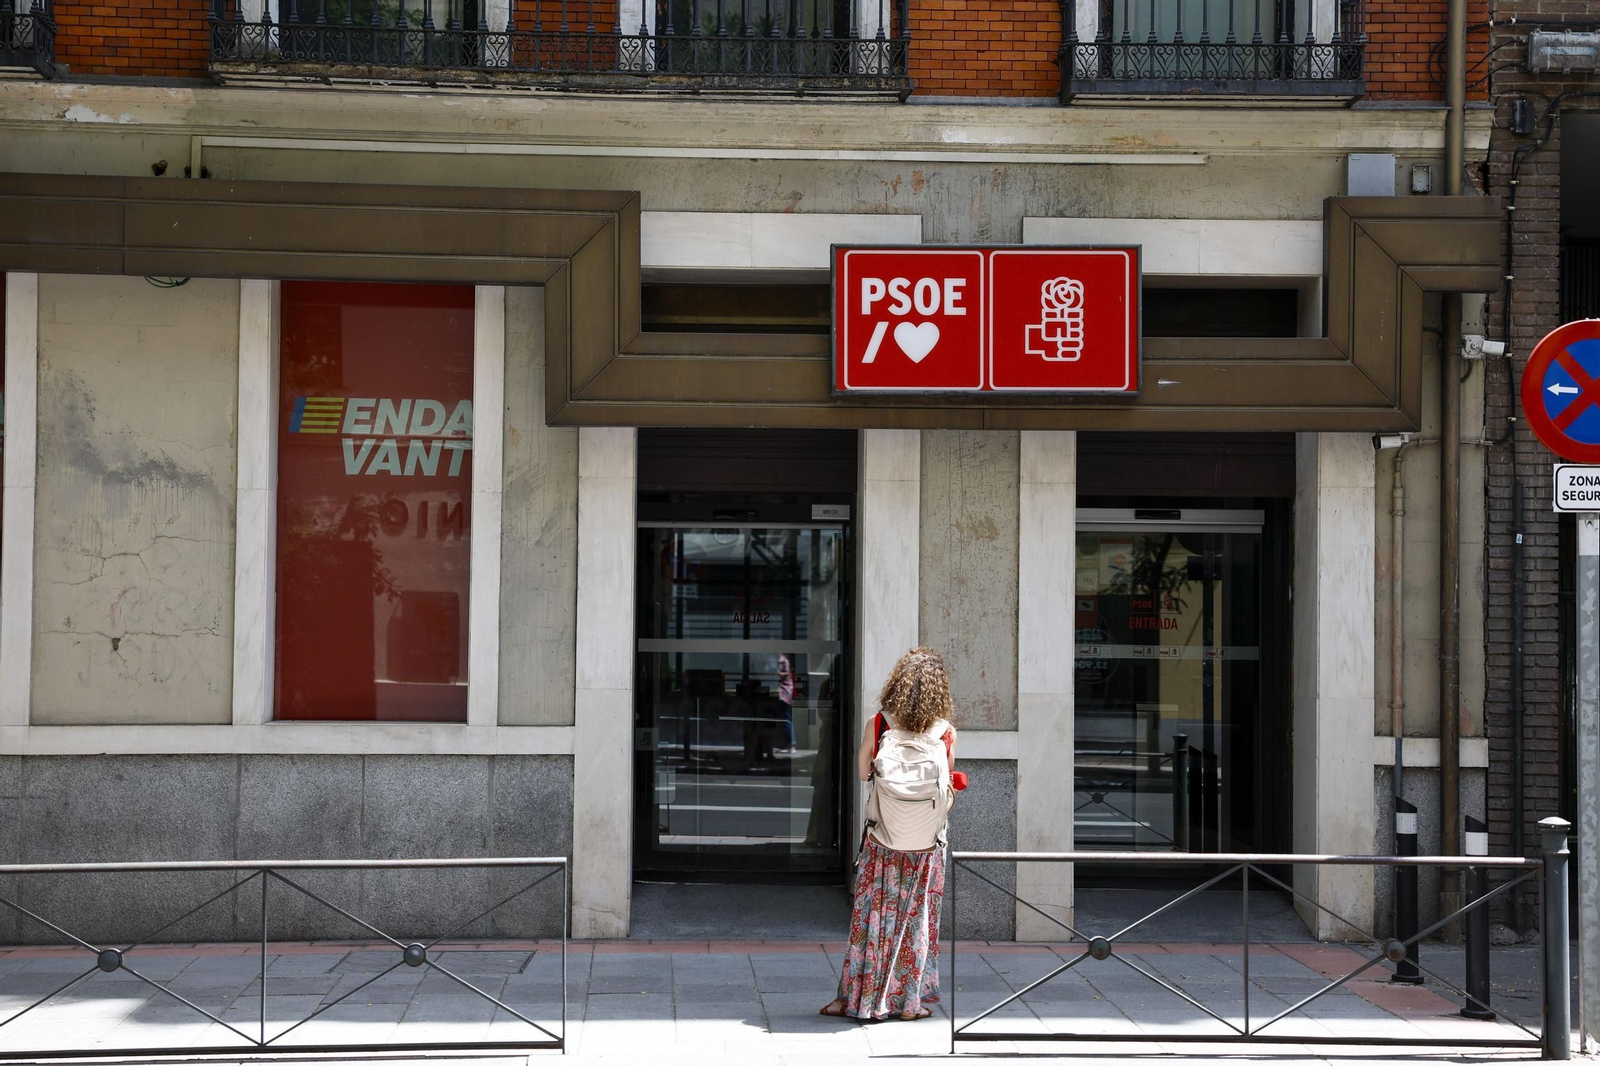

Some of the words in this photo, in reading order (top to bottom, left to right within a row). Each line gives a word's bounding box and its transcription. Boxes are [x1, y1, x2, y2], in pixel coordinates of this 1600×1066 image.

[861, 277, 967, 316] PSOE
[341, 397, 473, 438] ENDA
[341, 438, 472, 477] VANT
[1569, 475, 1600, 486] ZONA
[1562, 490, 1600, 501] SEGUR
[1132, 600, 1153, 609] PSOE
[1128, 616, 1178, 630] ENTRADA
